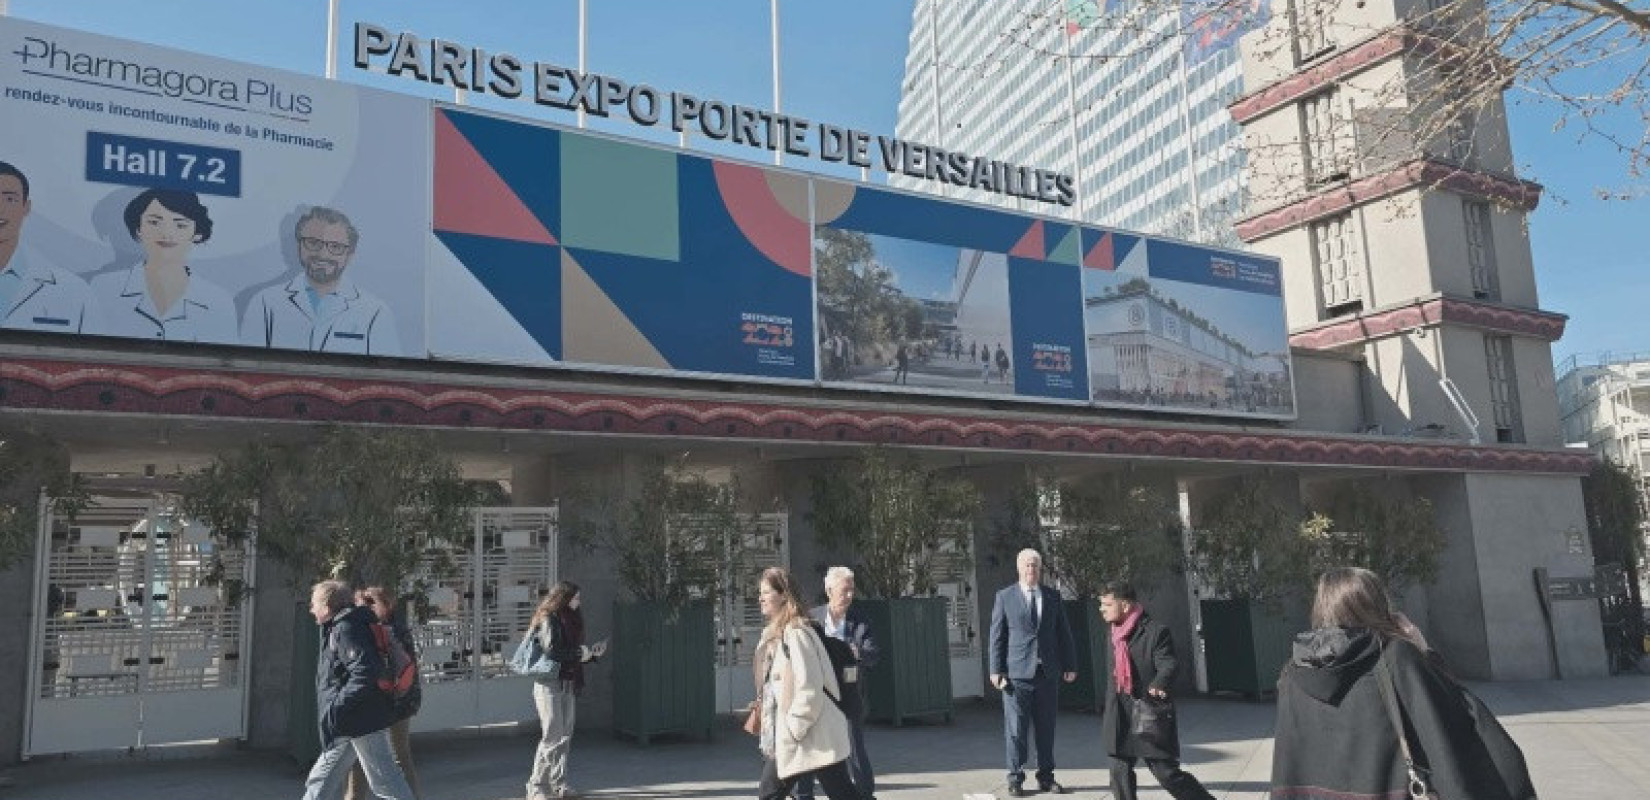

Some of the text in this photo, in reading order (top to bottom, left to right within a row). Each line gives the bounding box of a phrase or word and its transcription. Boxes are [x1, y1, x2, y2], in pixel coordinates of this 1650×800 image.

[12, 36, 313, 115] Pharmagora Plus
[5, 86, 335, 151] rendez-vous incontournable de la Pharmacie
[354, 22, 1076, 207] PARIS EXPO PORTE DE VERSAILLES
[103, 143, 227, 185] Hall 7.2
